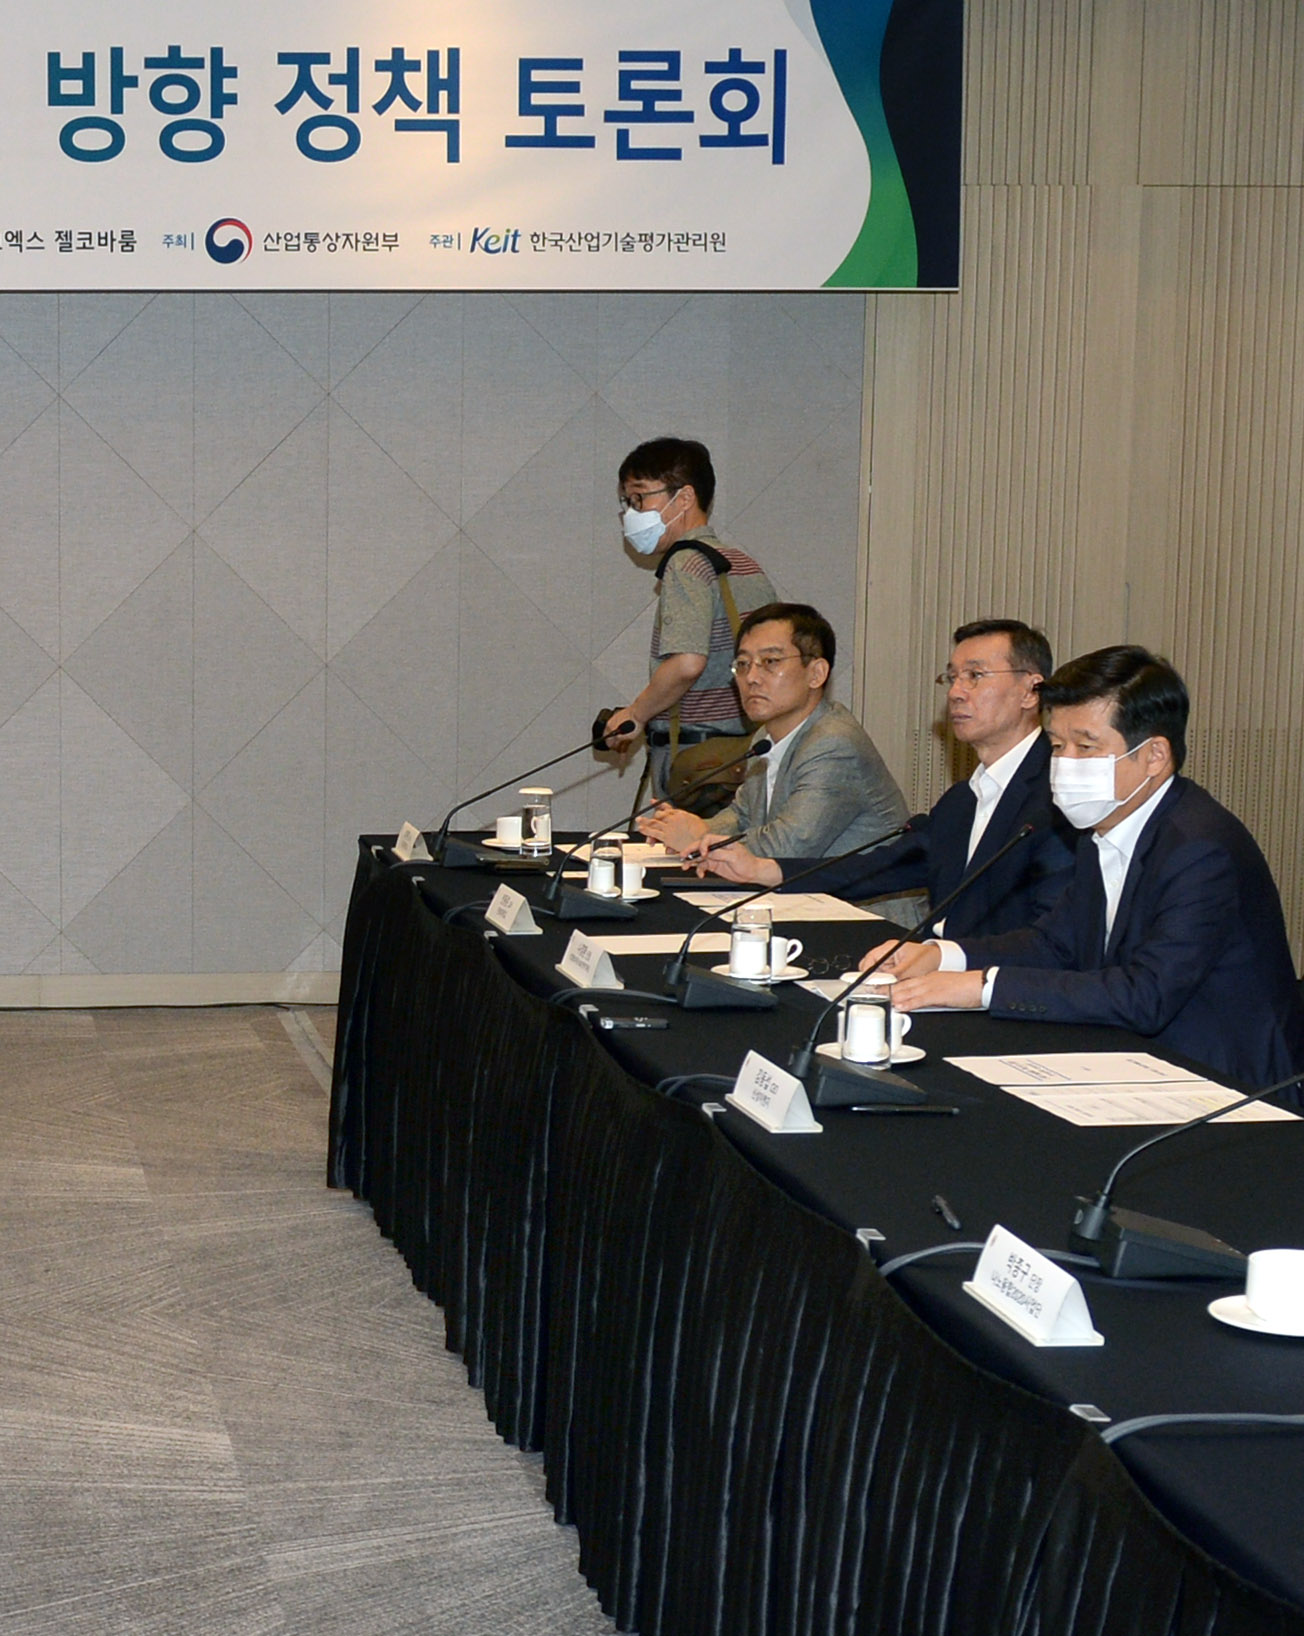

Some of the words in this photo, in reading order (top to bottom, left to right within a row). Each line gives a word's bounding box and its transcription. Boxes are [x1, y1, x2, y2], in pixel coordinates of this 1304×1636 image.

[48, 45, 238, 163] 방향
[274, 47, 460, 163] 정책
[505, 48, 787, 165] 토론회
[54, 229, 138, 254] 젤코바룸
[162, 234, 187, 250] 주최
[263, 230, 400, 255] 산업통상자원부
[429, 234, 455, 250] 주관
[469, 227, 522, 255] Keit
[530, 231, 727, 253] 한국산업기술평가관리원
